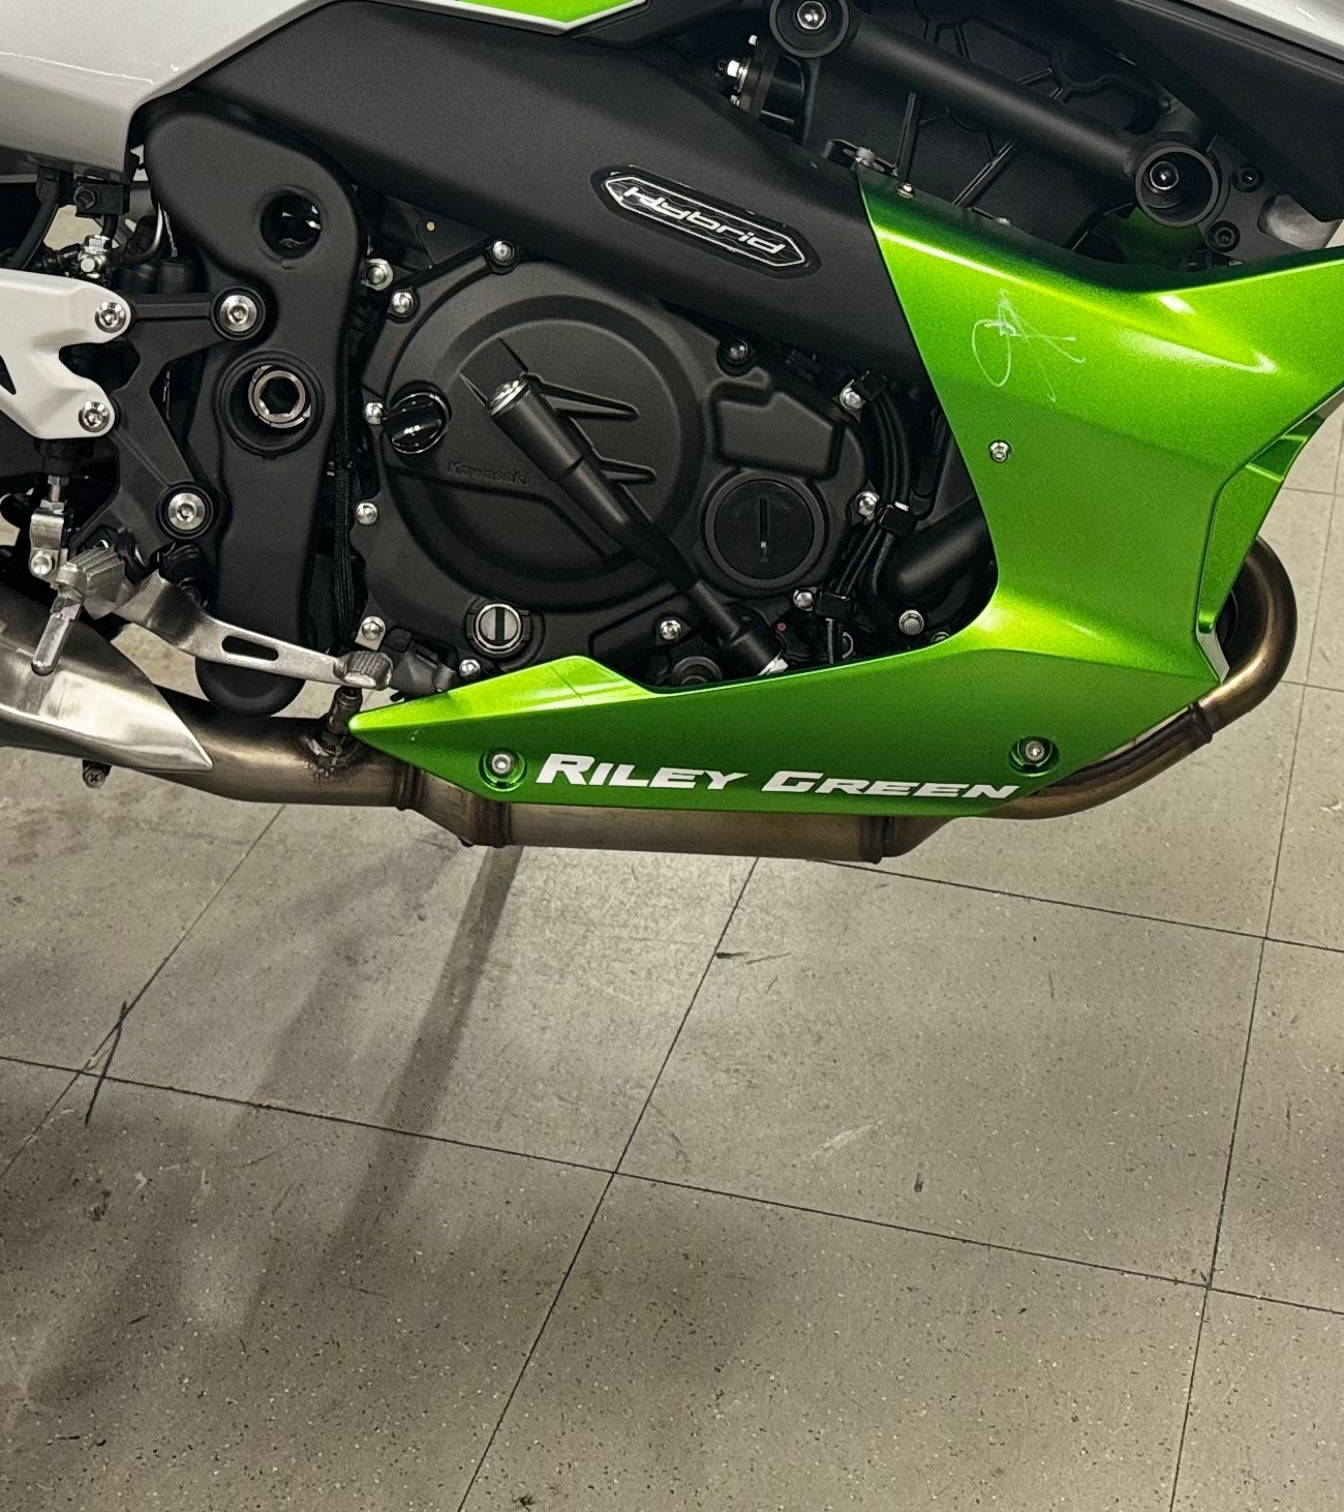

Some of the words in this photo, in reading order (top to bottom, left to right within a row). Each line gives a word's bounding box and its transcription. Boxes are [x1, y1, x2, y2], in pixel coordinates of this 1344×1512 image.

[622, 186, 786, 255] Hybrid
[536, 753, 748, 790] RILEY
[761, 771, 1020, 800] GREEN
